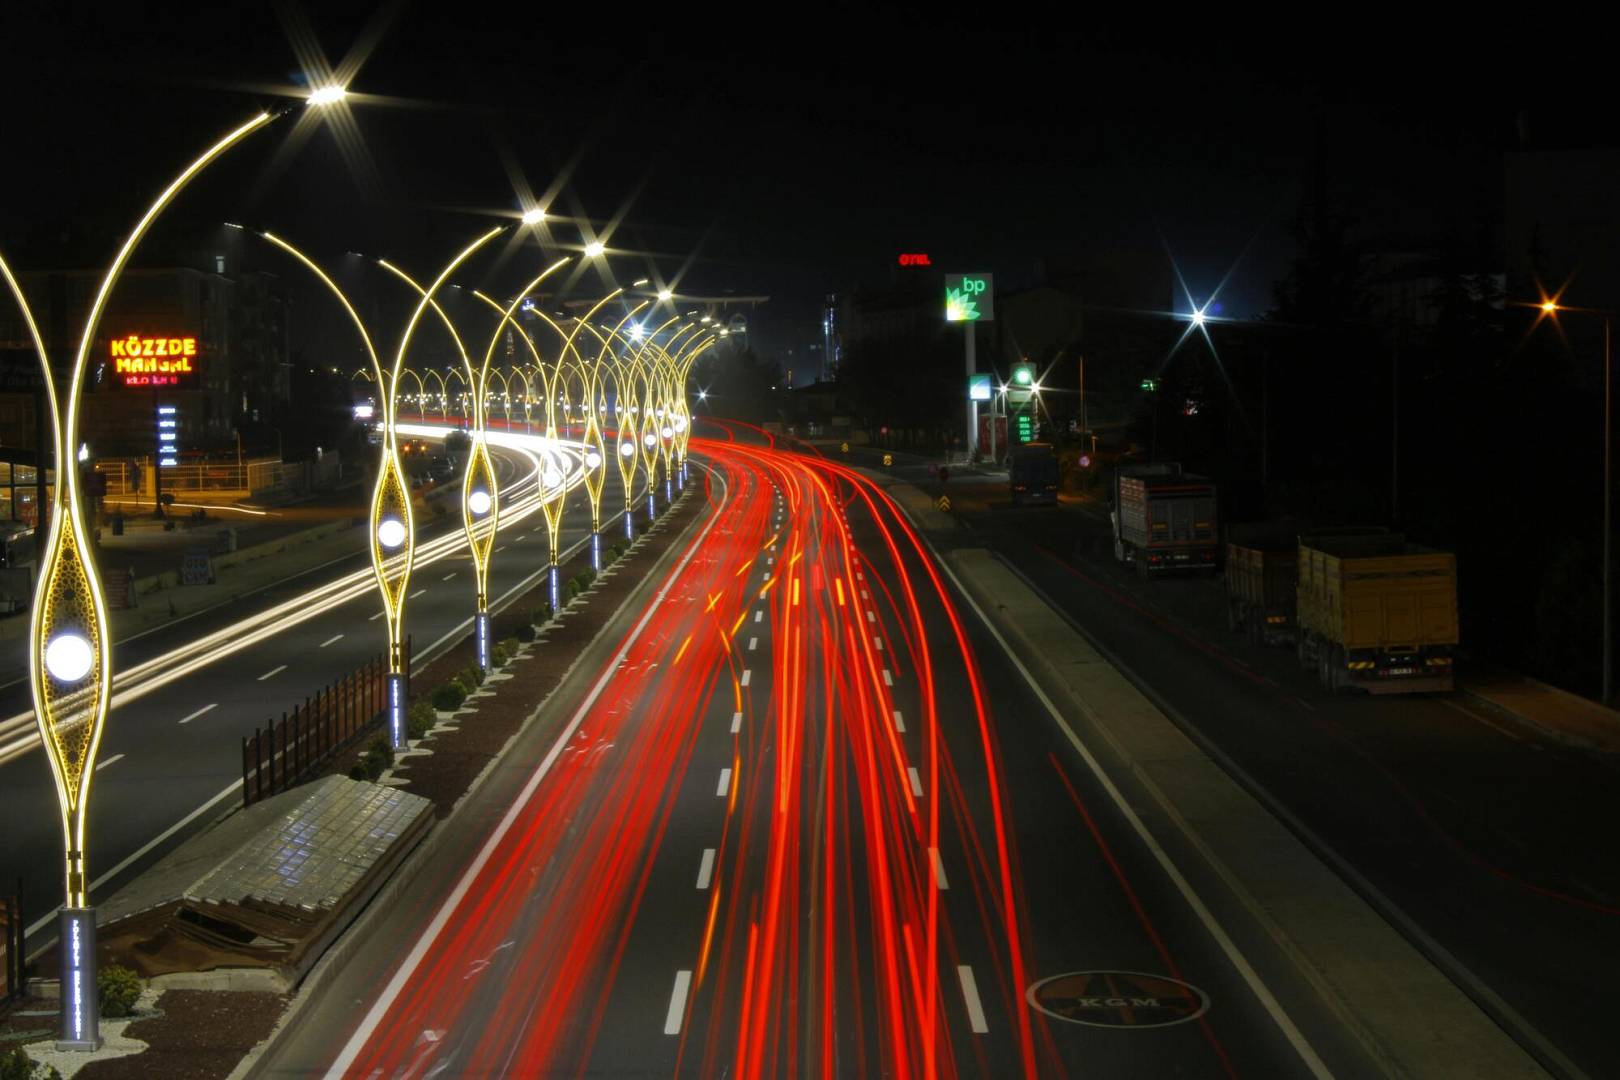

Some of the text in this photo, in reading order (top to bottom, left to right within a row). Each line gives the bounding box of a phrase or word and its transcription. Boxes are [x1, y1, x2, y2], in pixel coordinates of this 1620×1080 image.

[963, 277, 985, 295] bp
[111, 336, 196, 357] KÖZZDE
[1078, 997, 1161, 1007] KGM
